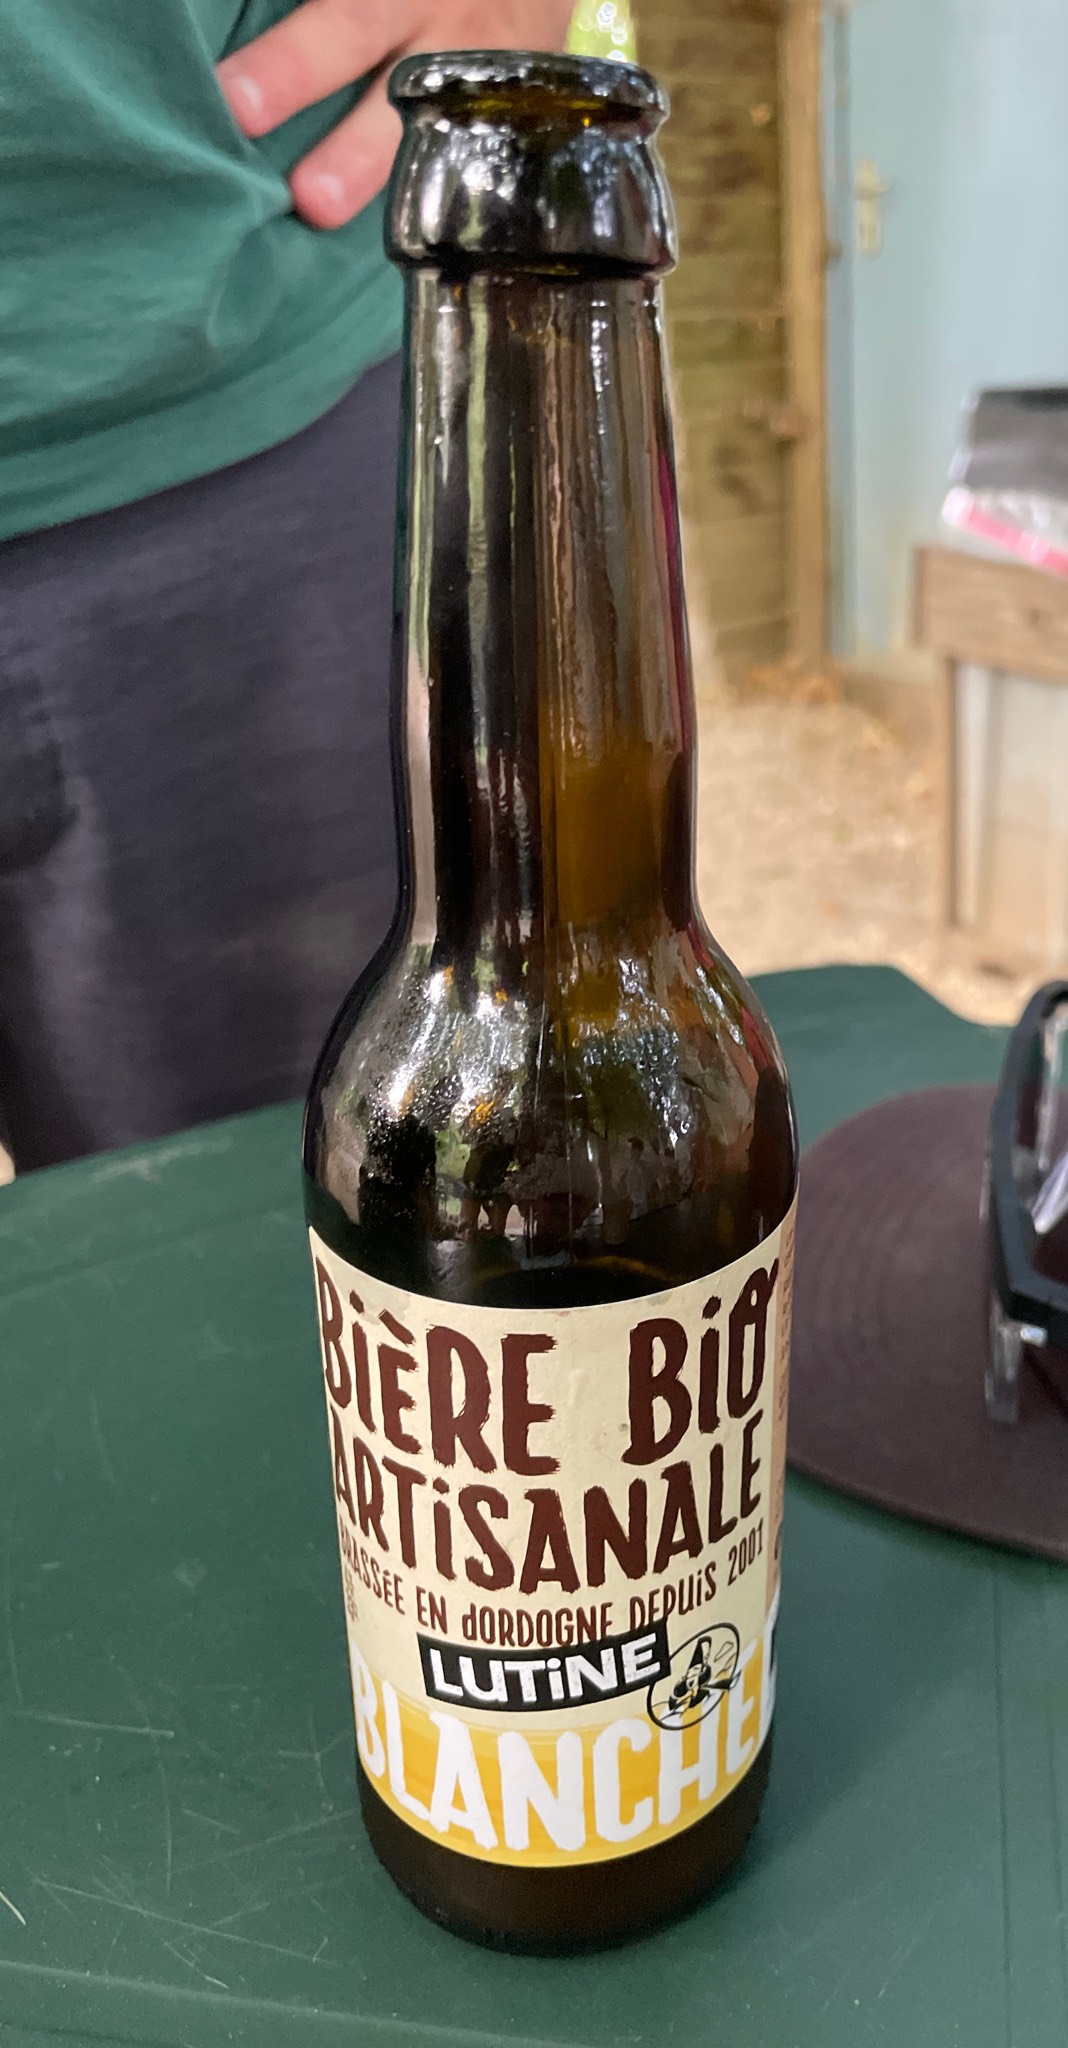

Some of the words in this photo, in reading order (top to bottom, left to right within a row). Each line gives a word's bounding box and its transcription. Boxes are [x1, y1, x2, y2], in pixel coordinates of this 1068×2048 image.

[416, 1585, 448, 1635] EN
[727, 1518, 765, 1586] 2001
[428, 1633, 661, 1703] LUTiNE
[351, 1637, 758, 1852] BLANCHE
